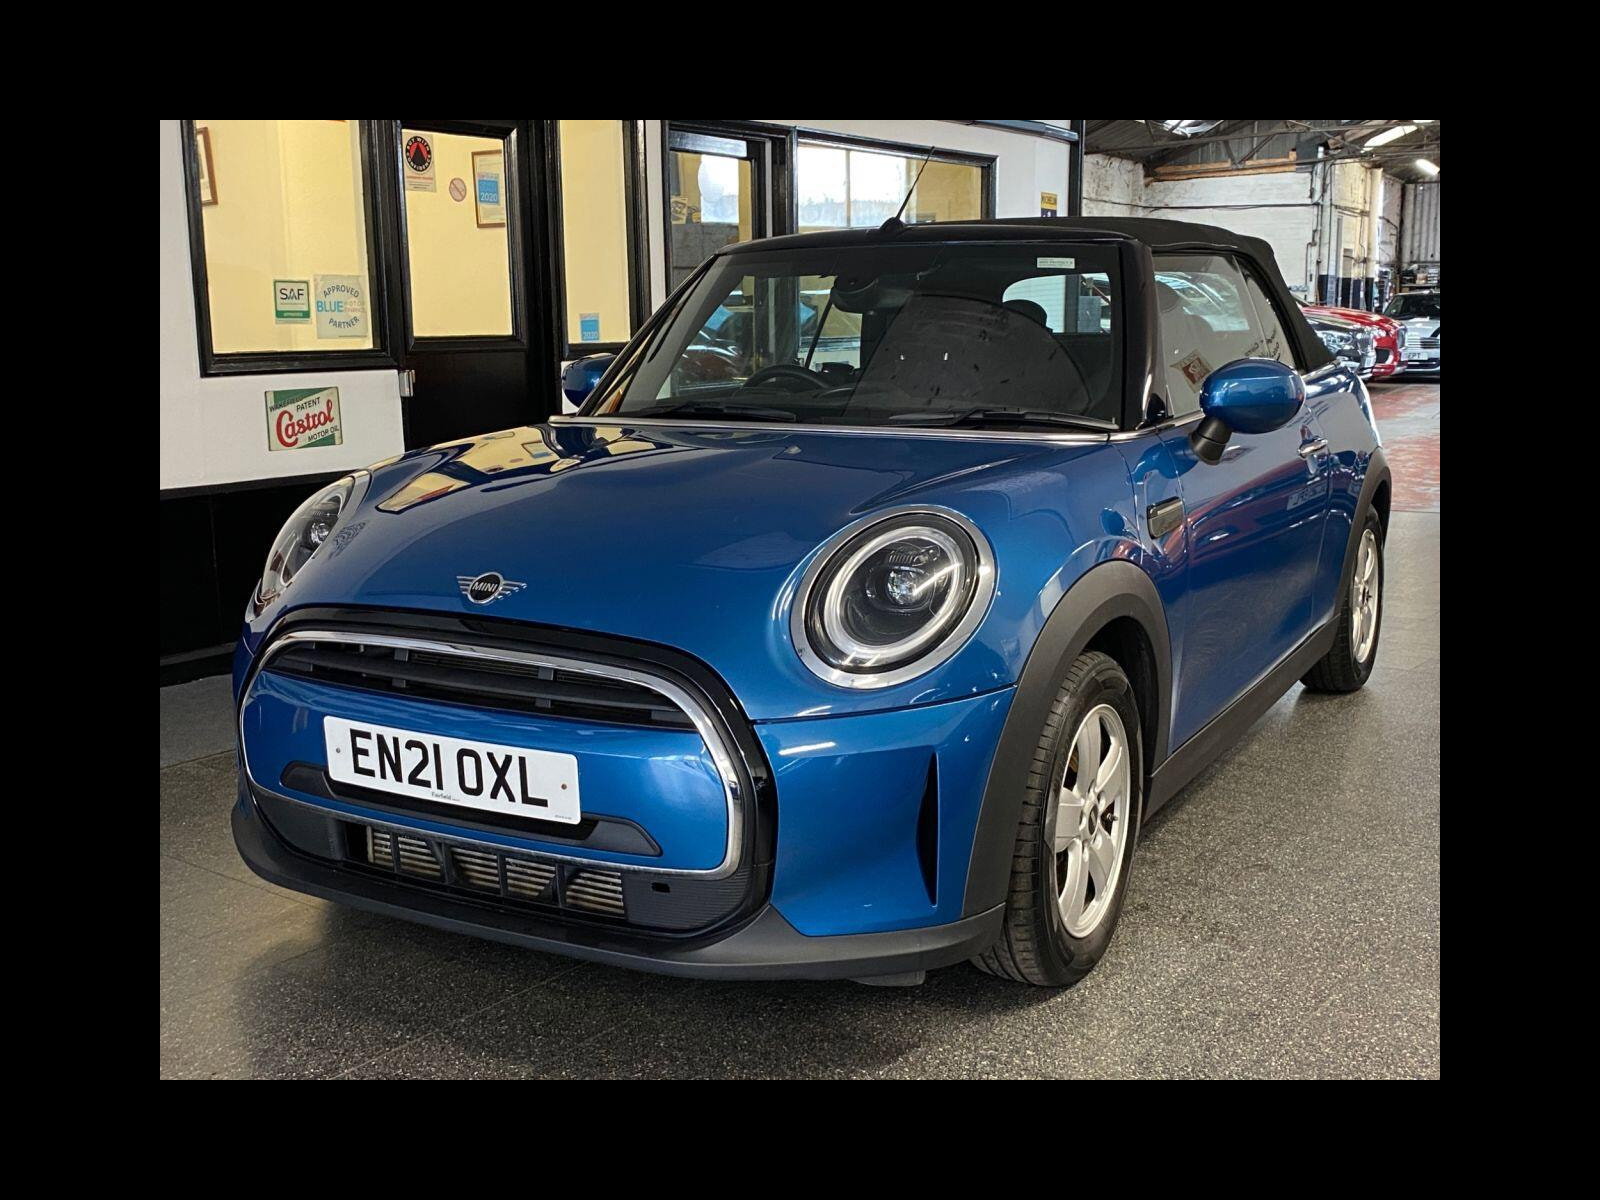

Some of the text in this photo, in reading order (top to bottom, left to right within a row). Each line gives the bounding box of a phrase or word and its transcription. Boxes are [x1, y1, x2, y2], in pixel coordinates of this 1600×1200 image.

[480, 192, 498, 201] 2020
[279, 287, 305, 301] SAF
[323, 284, 360, 299] APPROVED
[316, 300, 344, 313] BLUE
[328, 316, 360, 329] PARTNER
[296, 397, 321, 412] PATENT
[276, 399, 335, 448] Castrol
[307, 425, 340, 443] MOTOR OIL
[472, 581, 498, 593] MINI
[350, 728, 549, 808] EN21 OXL
